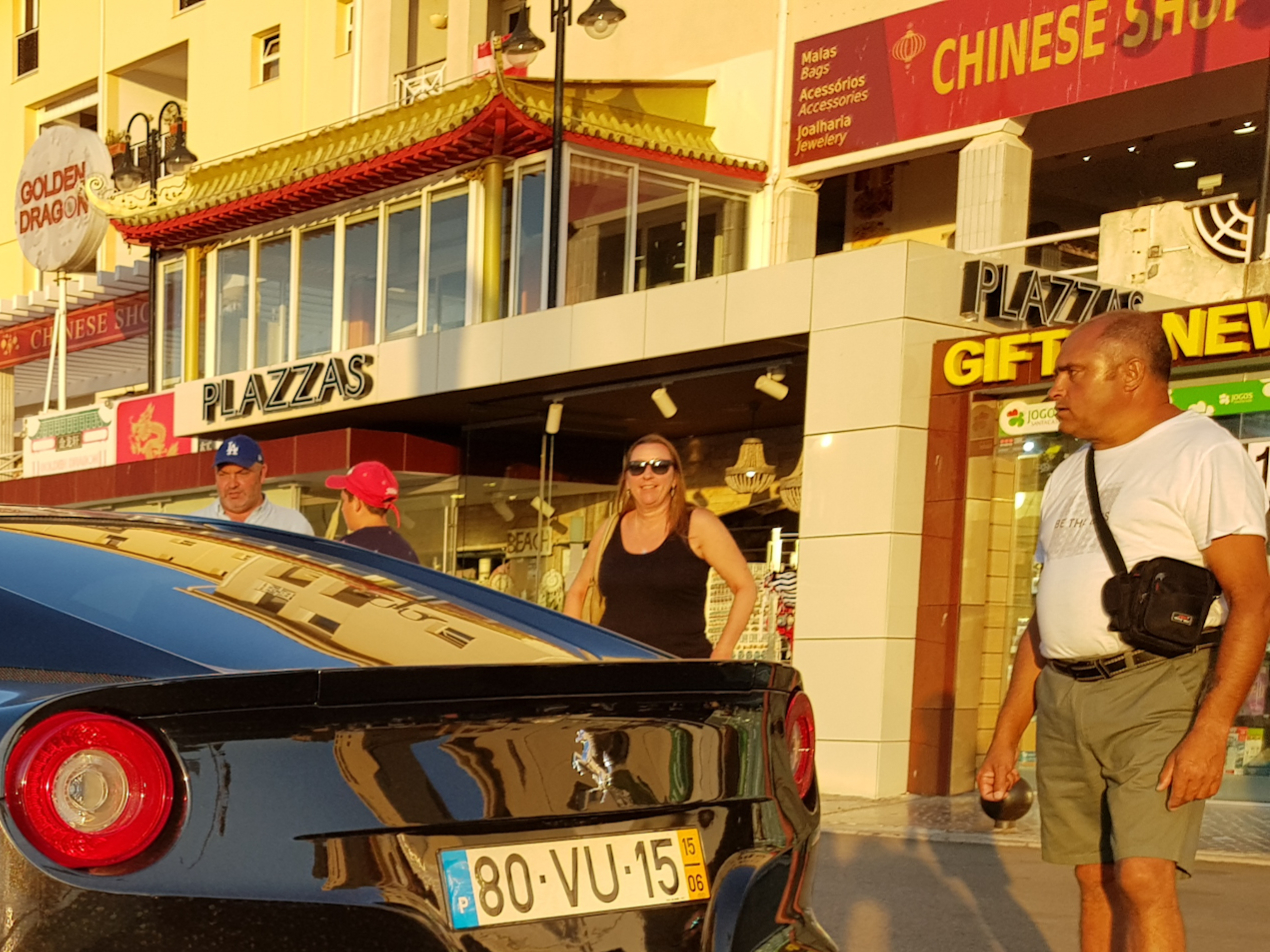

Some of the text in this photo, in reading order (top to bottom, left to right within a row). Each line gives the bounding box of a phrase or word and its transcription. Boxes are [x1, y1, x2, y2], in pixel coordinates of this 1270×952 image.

[801, 46, 838, 66] Malas
[932, 0, 1108, 95] CHINESE
[800, 63, 830, 80] Bags
[799, 75, 866, 102] Acessórios
[797, 89, 869, 117] Accessories
[796, 114, 852, 140] Joalharia
[794, 132, 848, 156] Jewelery
[21, 162, 86, 205] GOLDEN
[19, 196, 88, 234] DRAGON
[30, 302, 149, 350] CHNESE SHO
[203, 354, 370, 422] PLAZZAS
[1027, 408, 1057, 424] JOGO
[507, 531, 549, 553] BEACH
[681, 837, 697, 856] 15
[687, 874, 705, 893] 06
[458, 896, 469, 914] P
